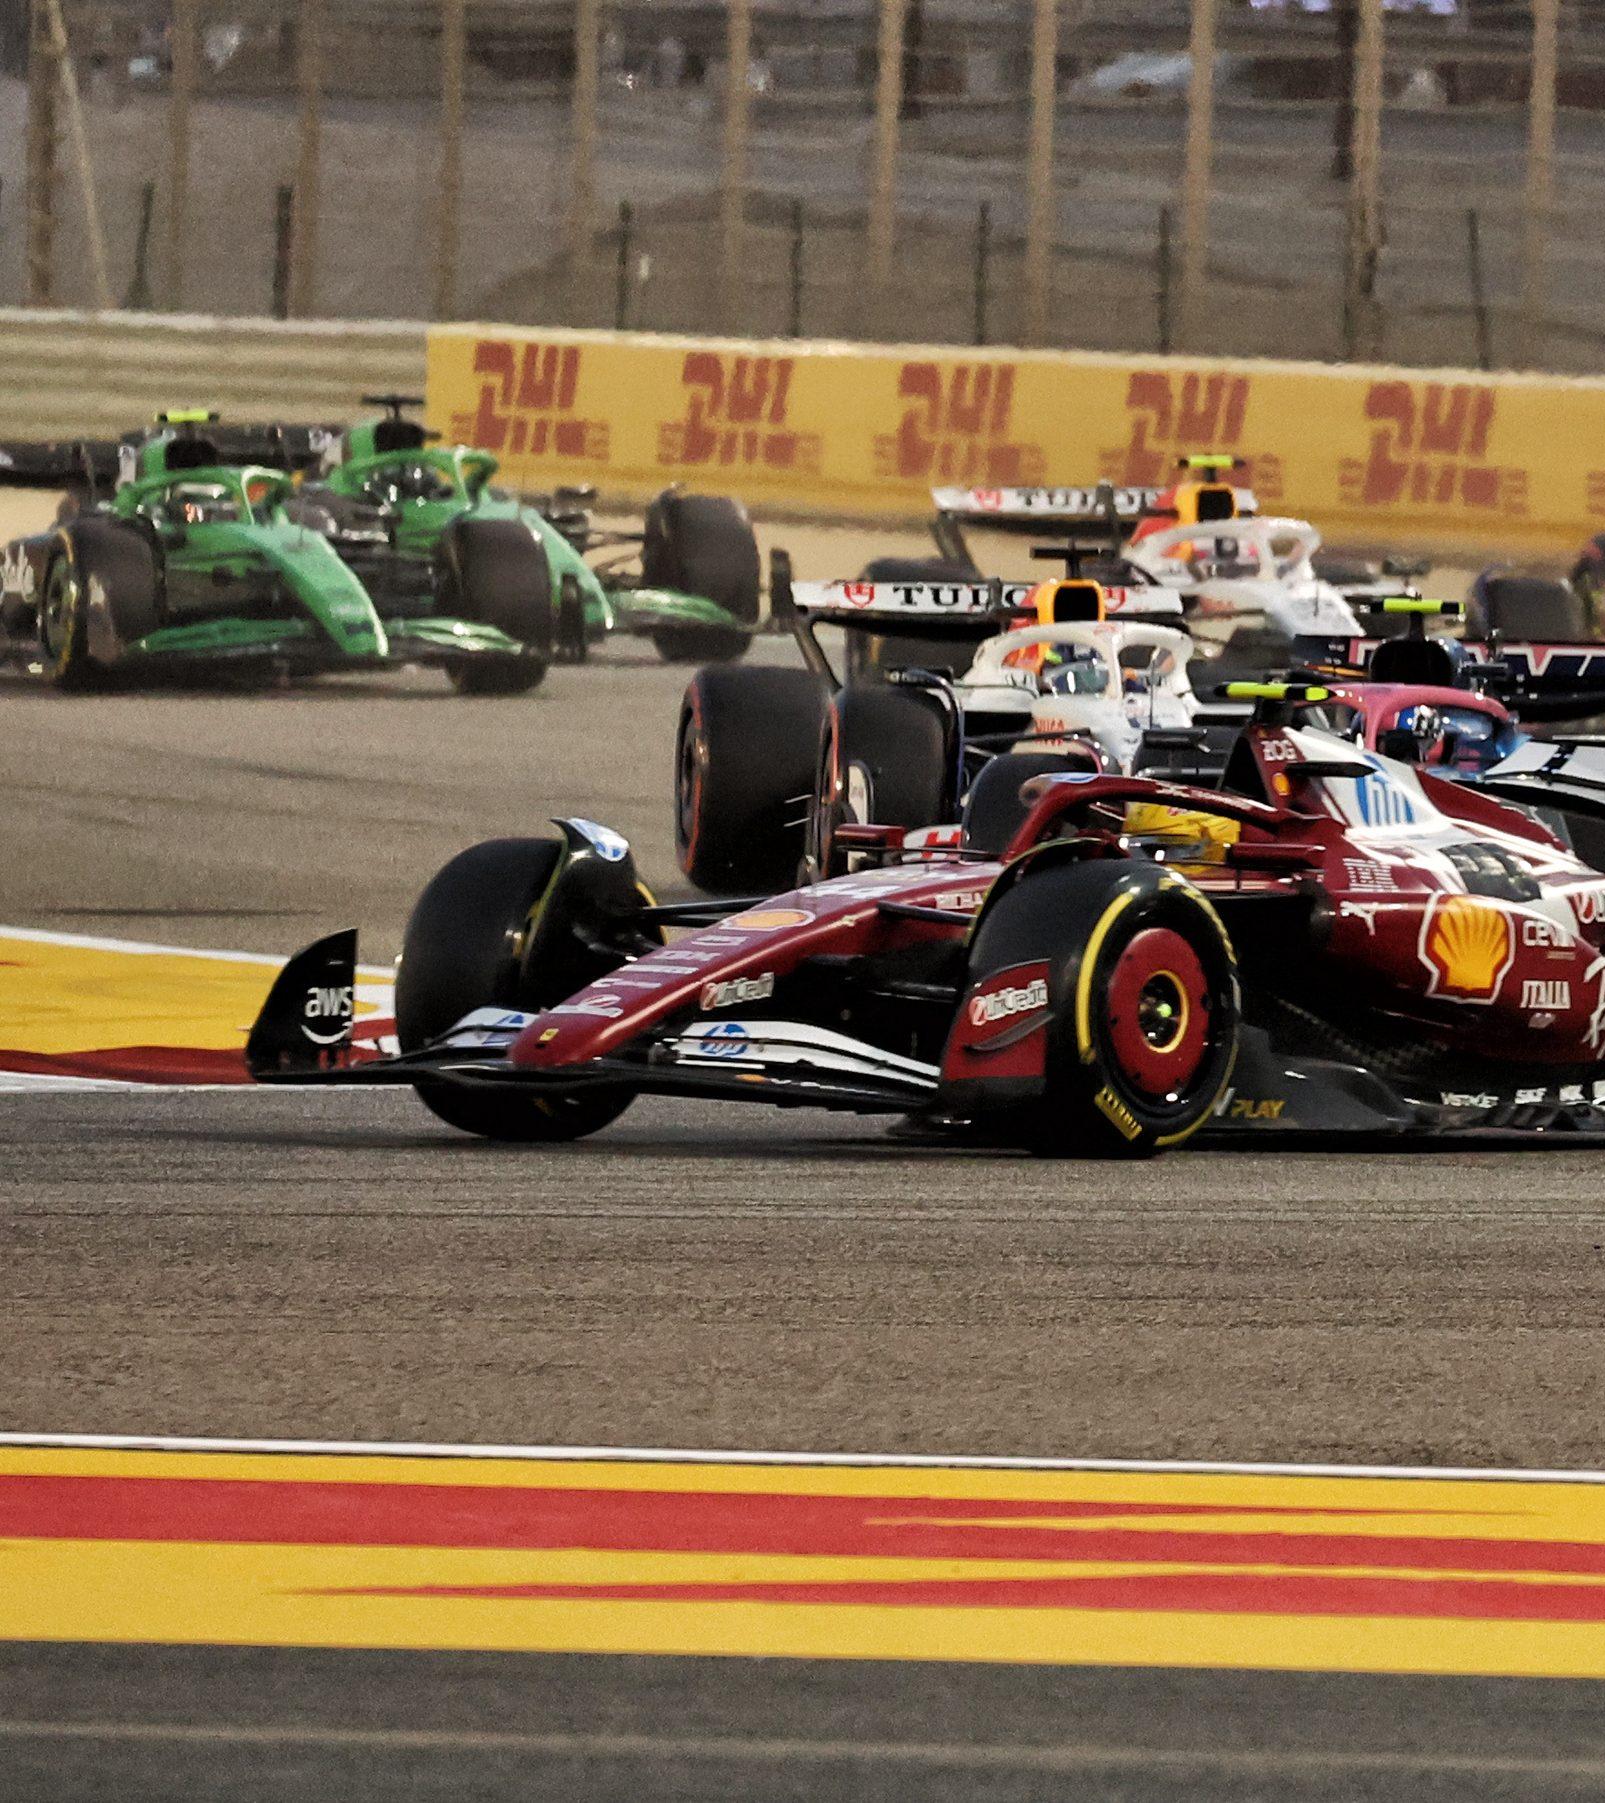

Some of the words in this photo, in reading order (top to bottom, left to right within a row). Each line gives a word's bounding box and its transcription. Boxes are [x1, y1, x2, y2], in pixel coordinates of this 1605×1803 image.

[473, 341, 586, 456] DHL
[681, 352, 797, 468] DHL
[1364, 380, 1501, 508] DHL
[305, 986, 353, 1018] aws
